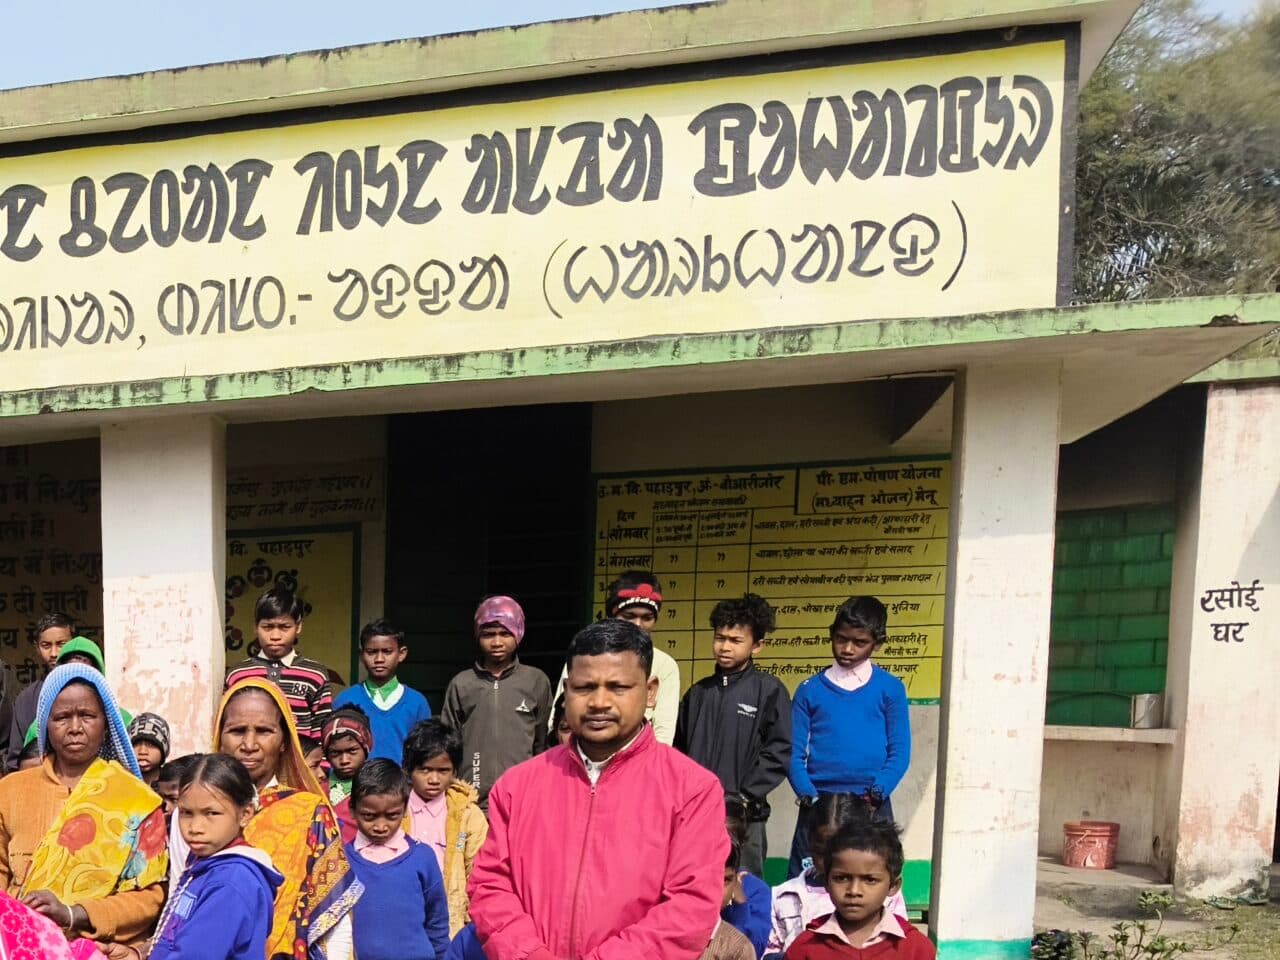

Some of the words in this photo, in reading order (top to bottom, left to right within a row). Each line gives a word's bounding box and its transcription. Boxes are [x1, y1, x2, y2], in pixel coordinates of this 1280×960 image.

[901, 464, 942, 480] योजना
[1200, 579, 1264, 612] रसोई
[1210, 622, 1250, 643] घर
[472, 751, 481, 789] SUPER
